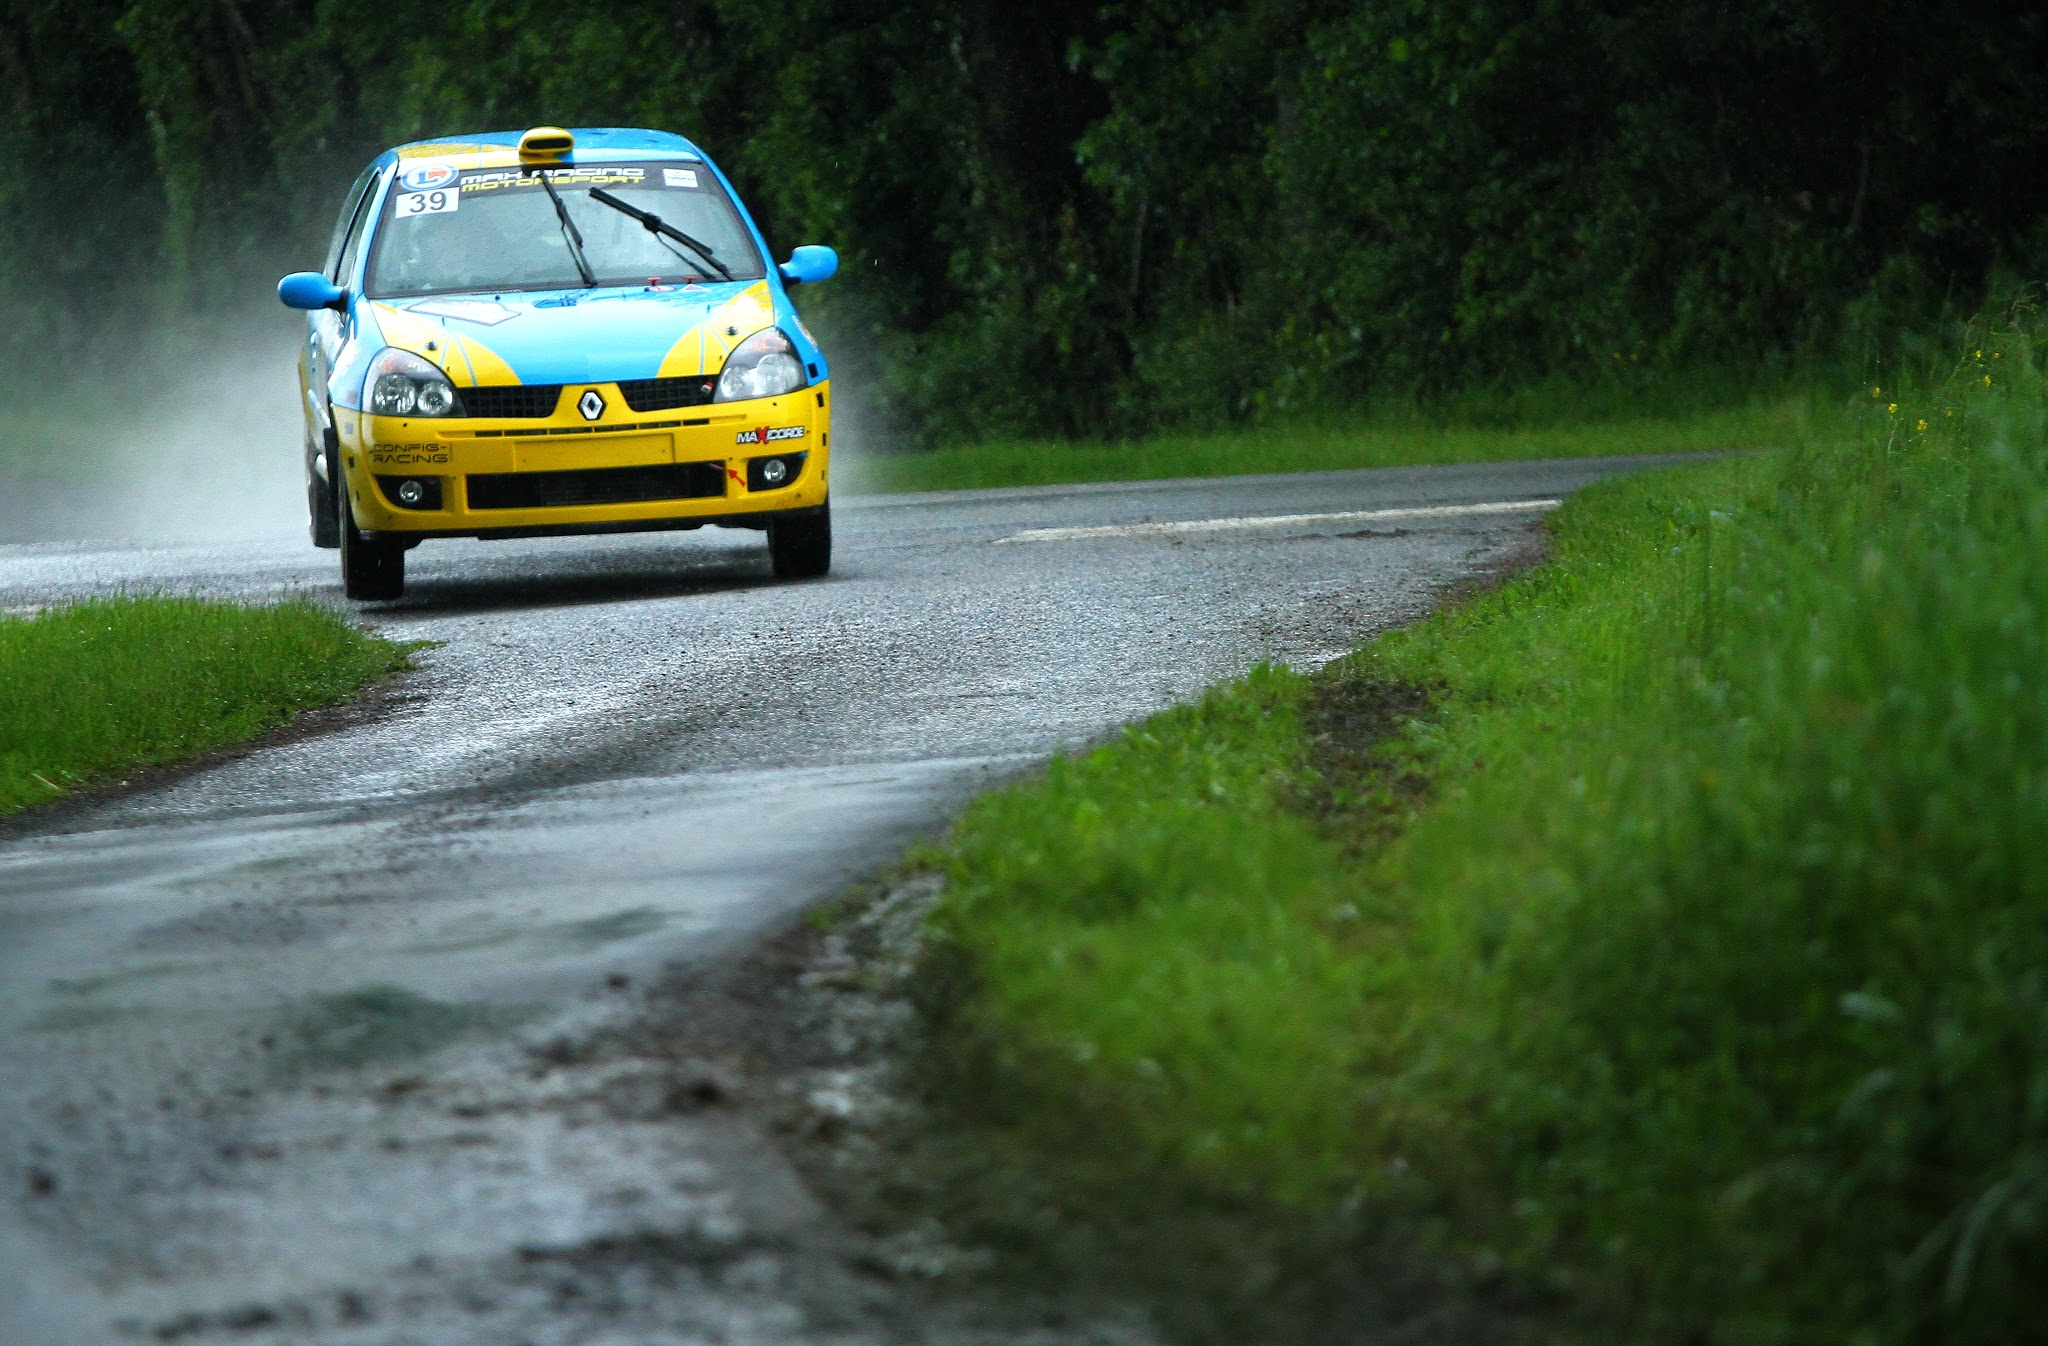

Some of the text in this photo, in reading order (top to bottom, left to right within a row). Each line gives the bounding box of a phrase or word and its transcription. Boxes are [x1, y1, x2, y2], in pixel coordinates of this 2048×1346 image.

[531, 167, 645, 179] RACING
[461, 176, 646, 193] MOTORSPORT
[409, 190, 447, 213] 39
[374, 453, 449, 464] RACING
